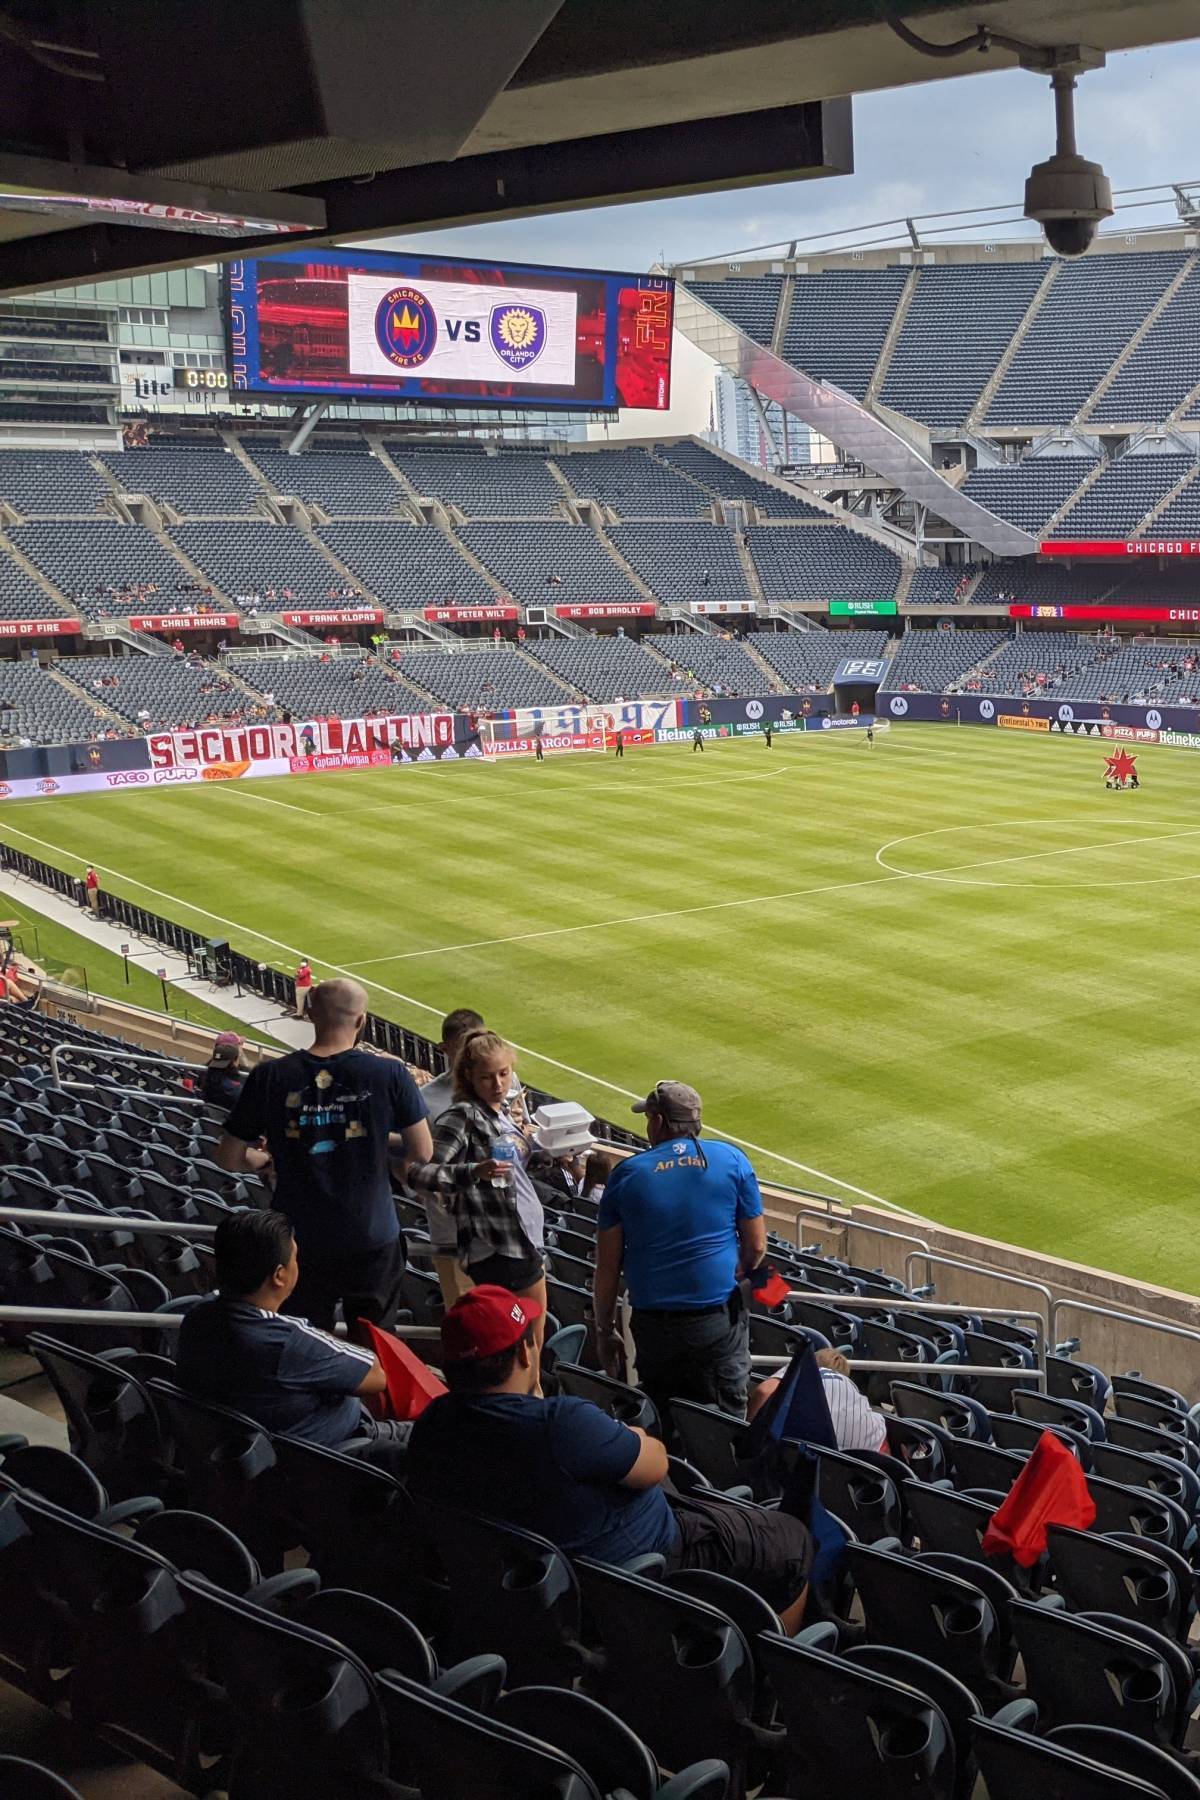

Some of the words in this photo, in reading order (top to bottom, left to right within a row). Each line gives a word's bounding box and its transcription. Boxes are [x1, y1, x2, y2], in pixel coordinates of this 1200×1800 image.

[388, 290, 424, 306] CHICAGO
[445, 319, 480, 342] VS
[390, 353, 408, 366] FIRE
[413, 354, 424, 364] FC
[188, 372, 227, 388] 0:00
[136, 378, 171, 399] Lite
[1127, 542, 1182, 553] CHICAGO
[310, 614, 338, 623] FRANK
[341, 614, 376, 622] KLOPAS
[458, 610, 483, 618] PETER
[20, 624, 34, 632] OF
[37, 624, 60, 632] FIRE
[193, 618, 226, 626] ARMAS
[742, 722, 760, 730] RUSH
[832, 718, 858, 726] motorola
[1000, 717, 1030, 727] Continental
[658, 727, 717, 741] Heineen
[1114, 728, 1133, 736] PIZZA
[1136, 730, 1157, 739] PUFF
[150, 724, 294, 769] SECTOR
[485, 738, 528, 753] WELLS
[532, 736, 571, 750] FARGO
[313, 755, 341, 769] Captain
[342, 754, 370, 767] Morgan
[108, 772, 149, 786] TACO
[155, 768, 198, 783] PUFF
[654, 1159, 674, 1172] An
[511, 1304, 522, 1322] CHI
